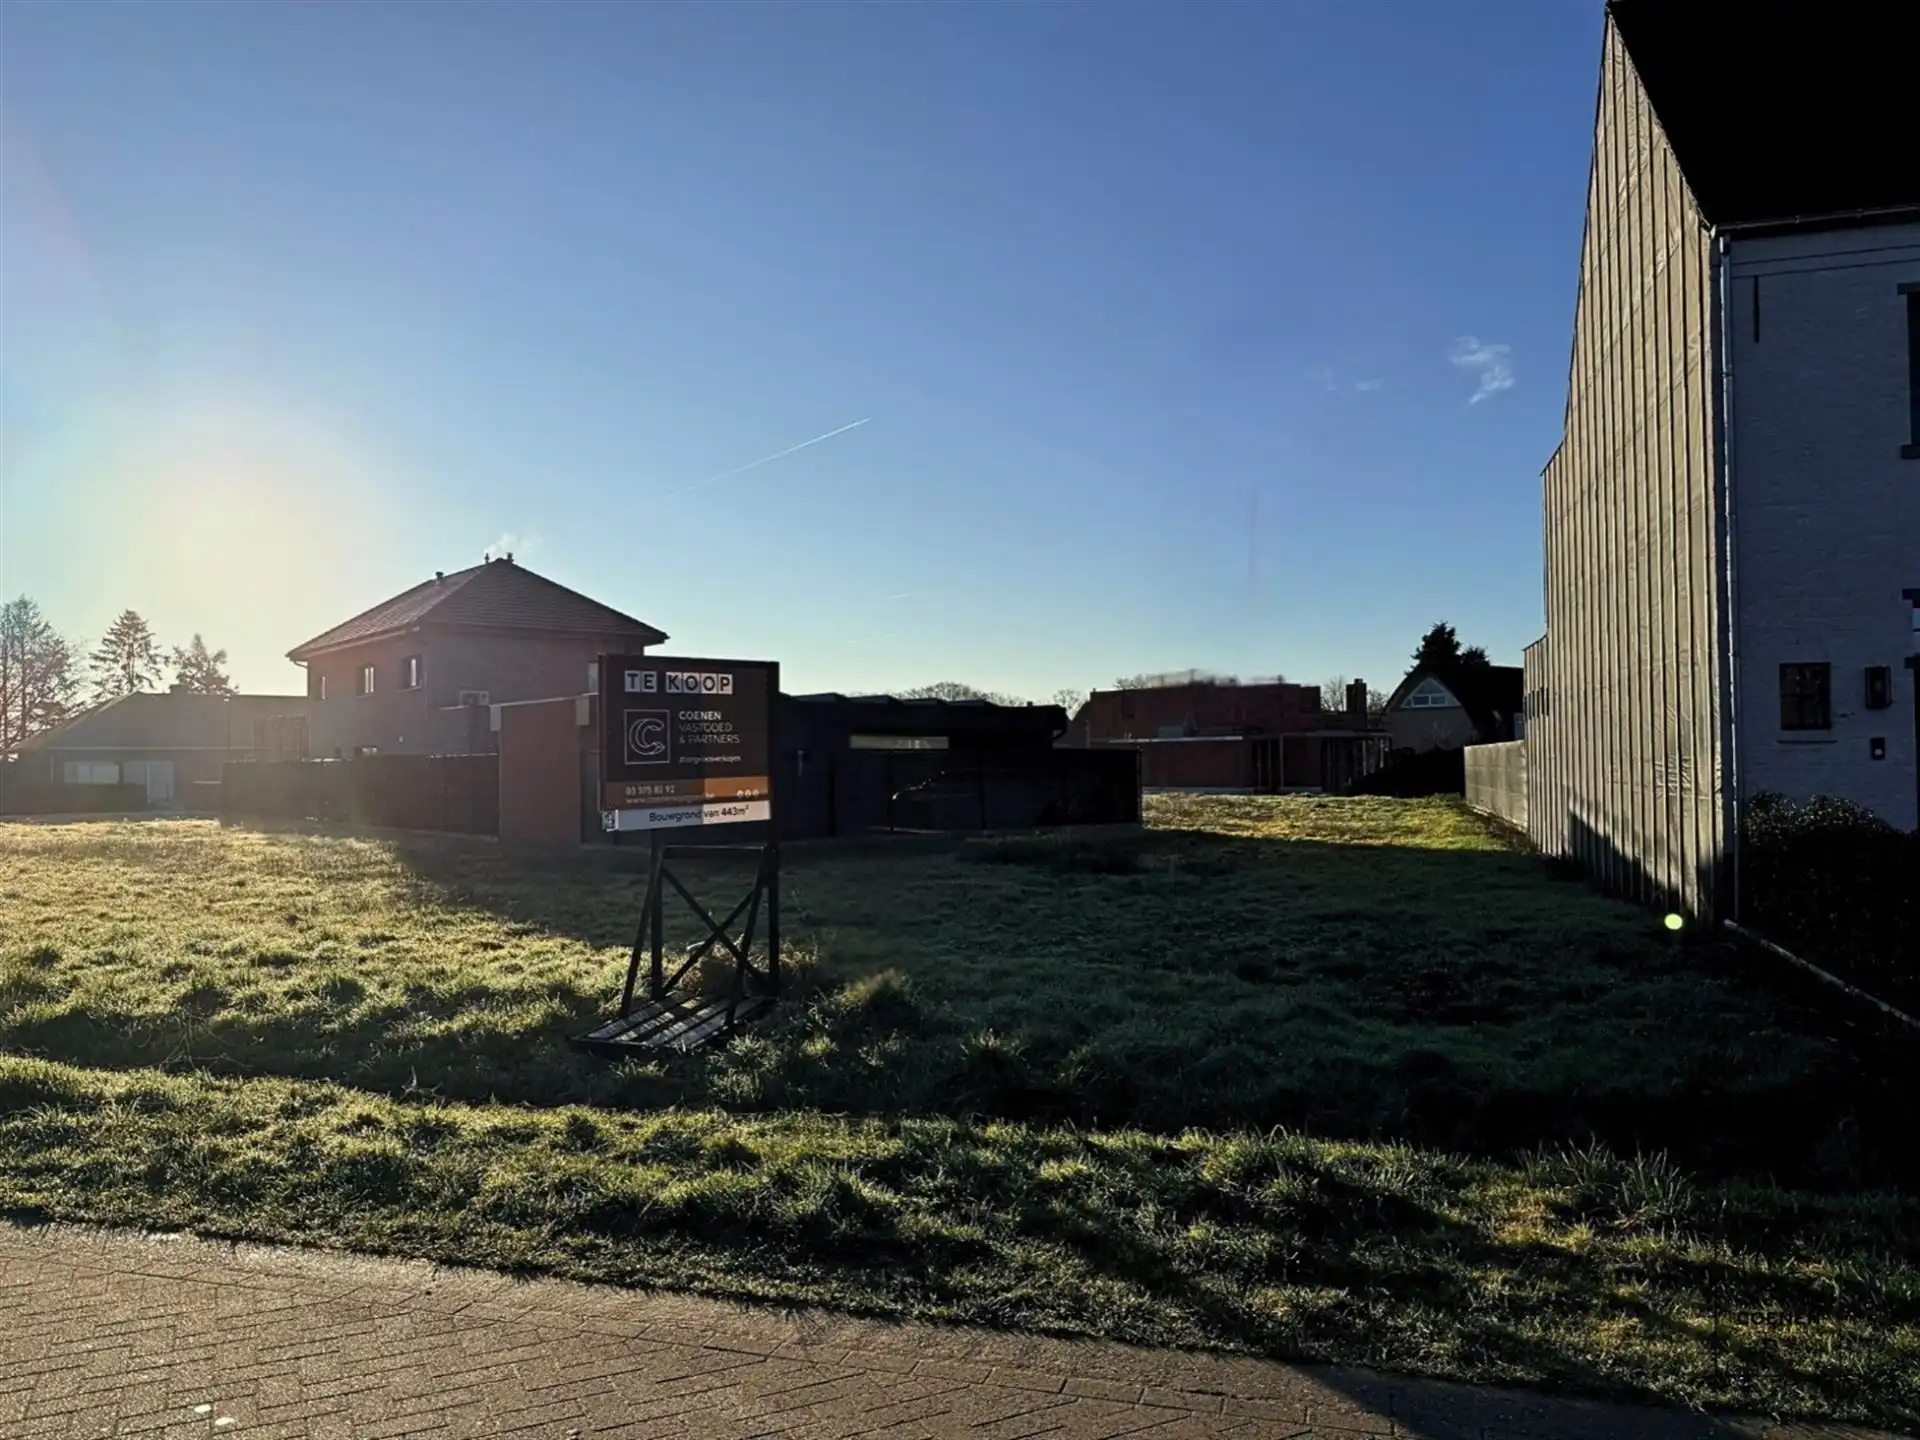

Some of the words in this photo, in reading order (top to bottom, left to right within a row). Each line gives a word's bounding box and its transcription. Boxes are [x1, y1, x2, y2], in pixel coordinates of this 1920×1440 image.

[626, 672, 656, 691] TE
[667, 672, 731, 693] KOOP
[678, 710, 721, 721] COENEN
[688, 734, 741, 744] PARTNERS
[649, 810, 702, 823] Bouwgrond
[703, 810, 720, 818] van
